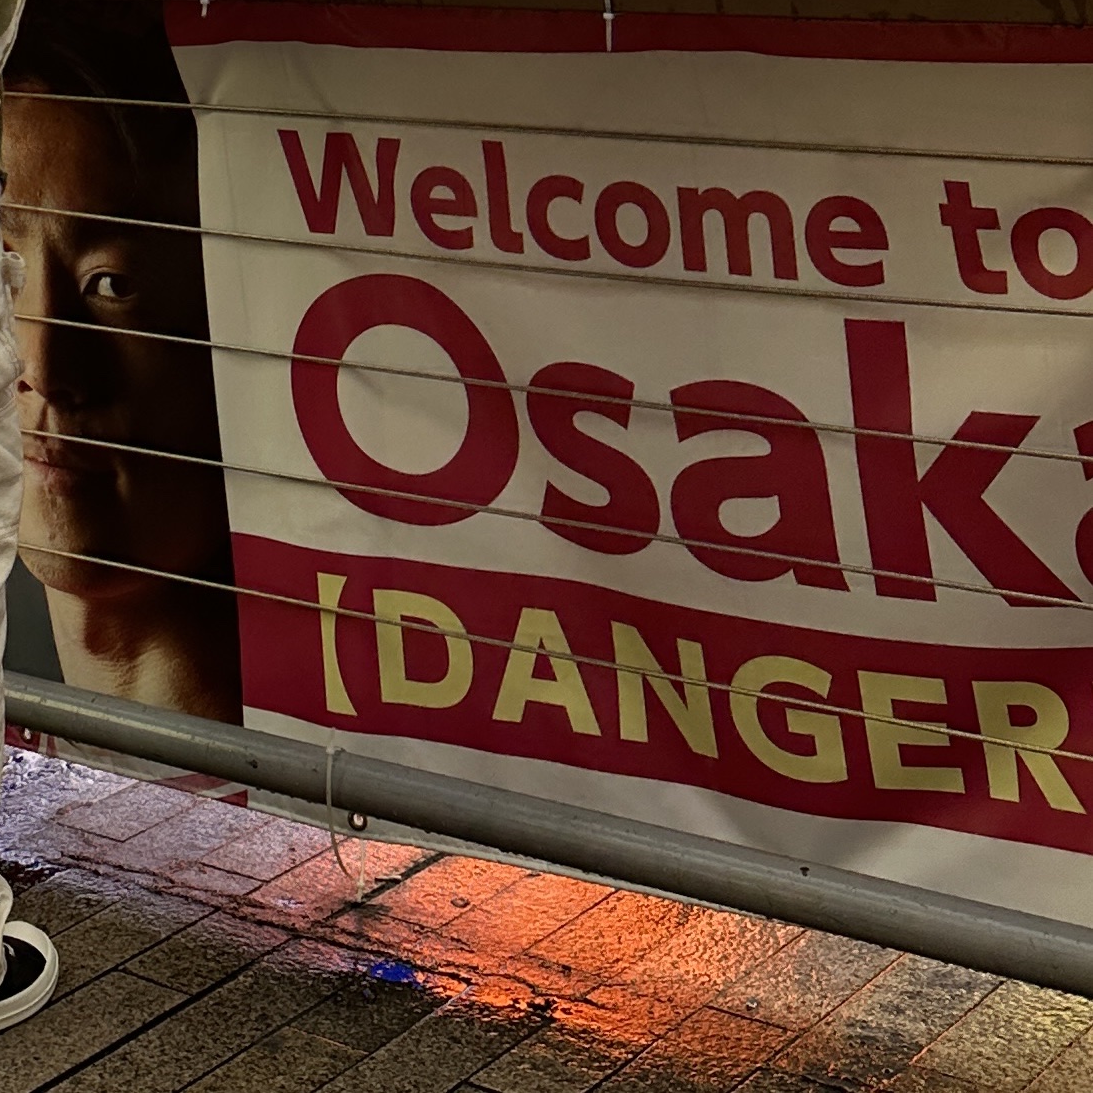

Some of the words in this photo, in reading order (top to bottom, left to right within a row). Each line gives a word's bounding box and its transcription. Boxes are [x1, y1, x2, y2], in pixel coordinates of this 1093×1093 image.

[276, 128, 890, 289] Welcome
[938, 179, 1093, 301] to
[290, 273, 1093, 609] Osak
